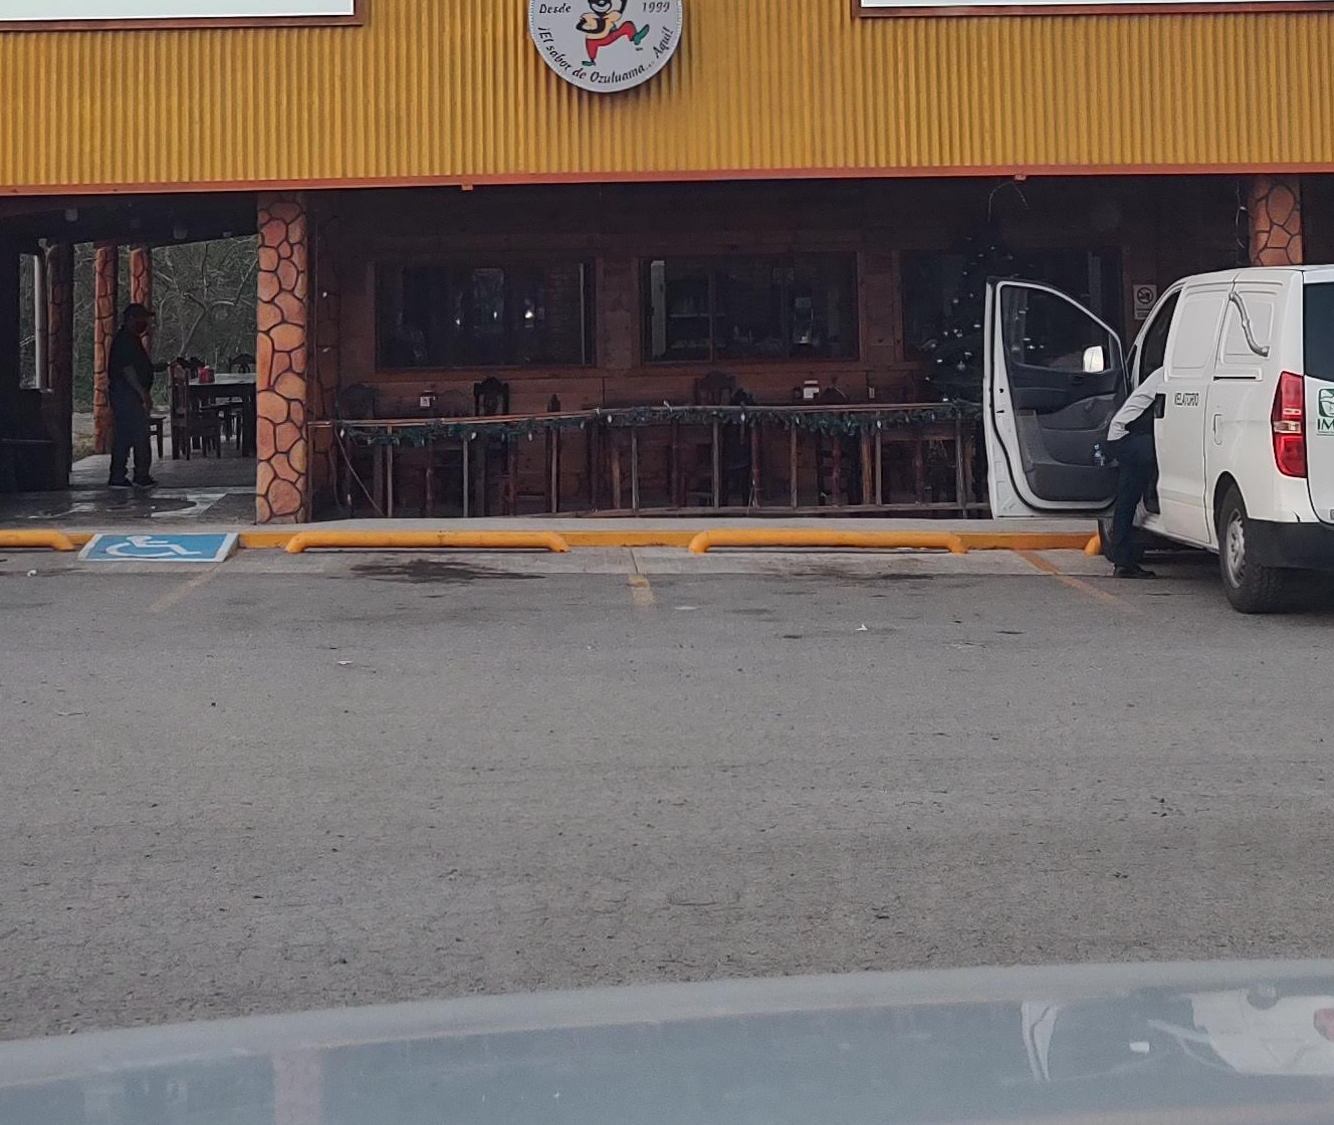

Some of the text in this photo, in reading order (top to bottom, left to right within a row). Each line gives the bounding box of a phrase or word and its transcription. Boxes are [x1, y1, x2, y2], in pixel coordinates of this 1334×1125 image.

[539, 2, 572, 14] Desde
[642, 1, 671, 14] 1999
[546, 44, 572, 71] sabor
[572, 67, 587, 81] de
